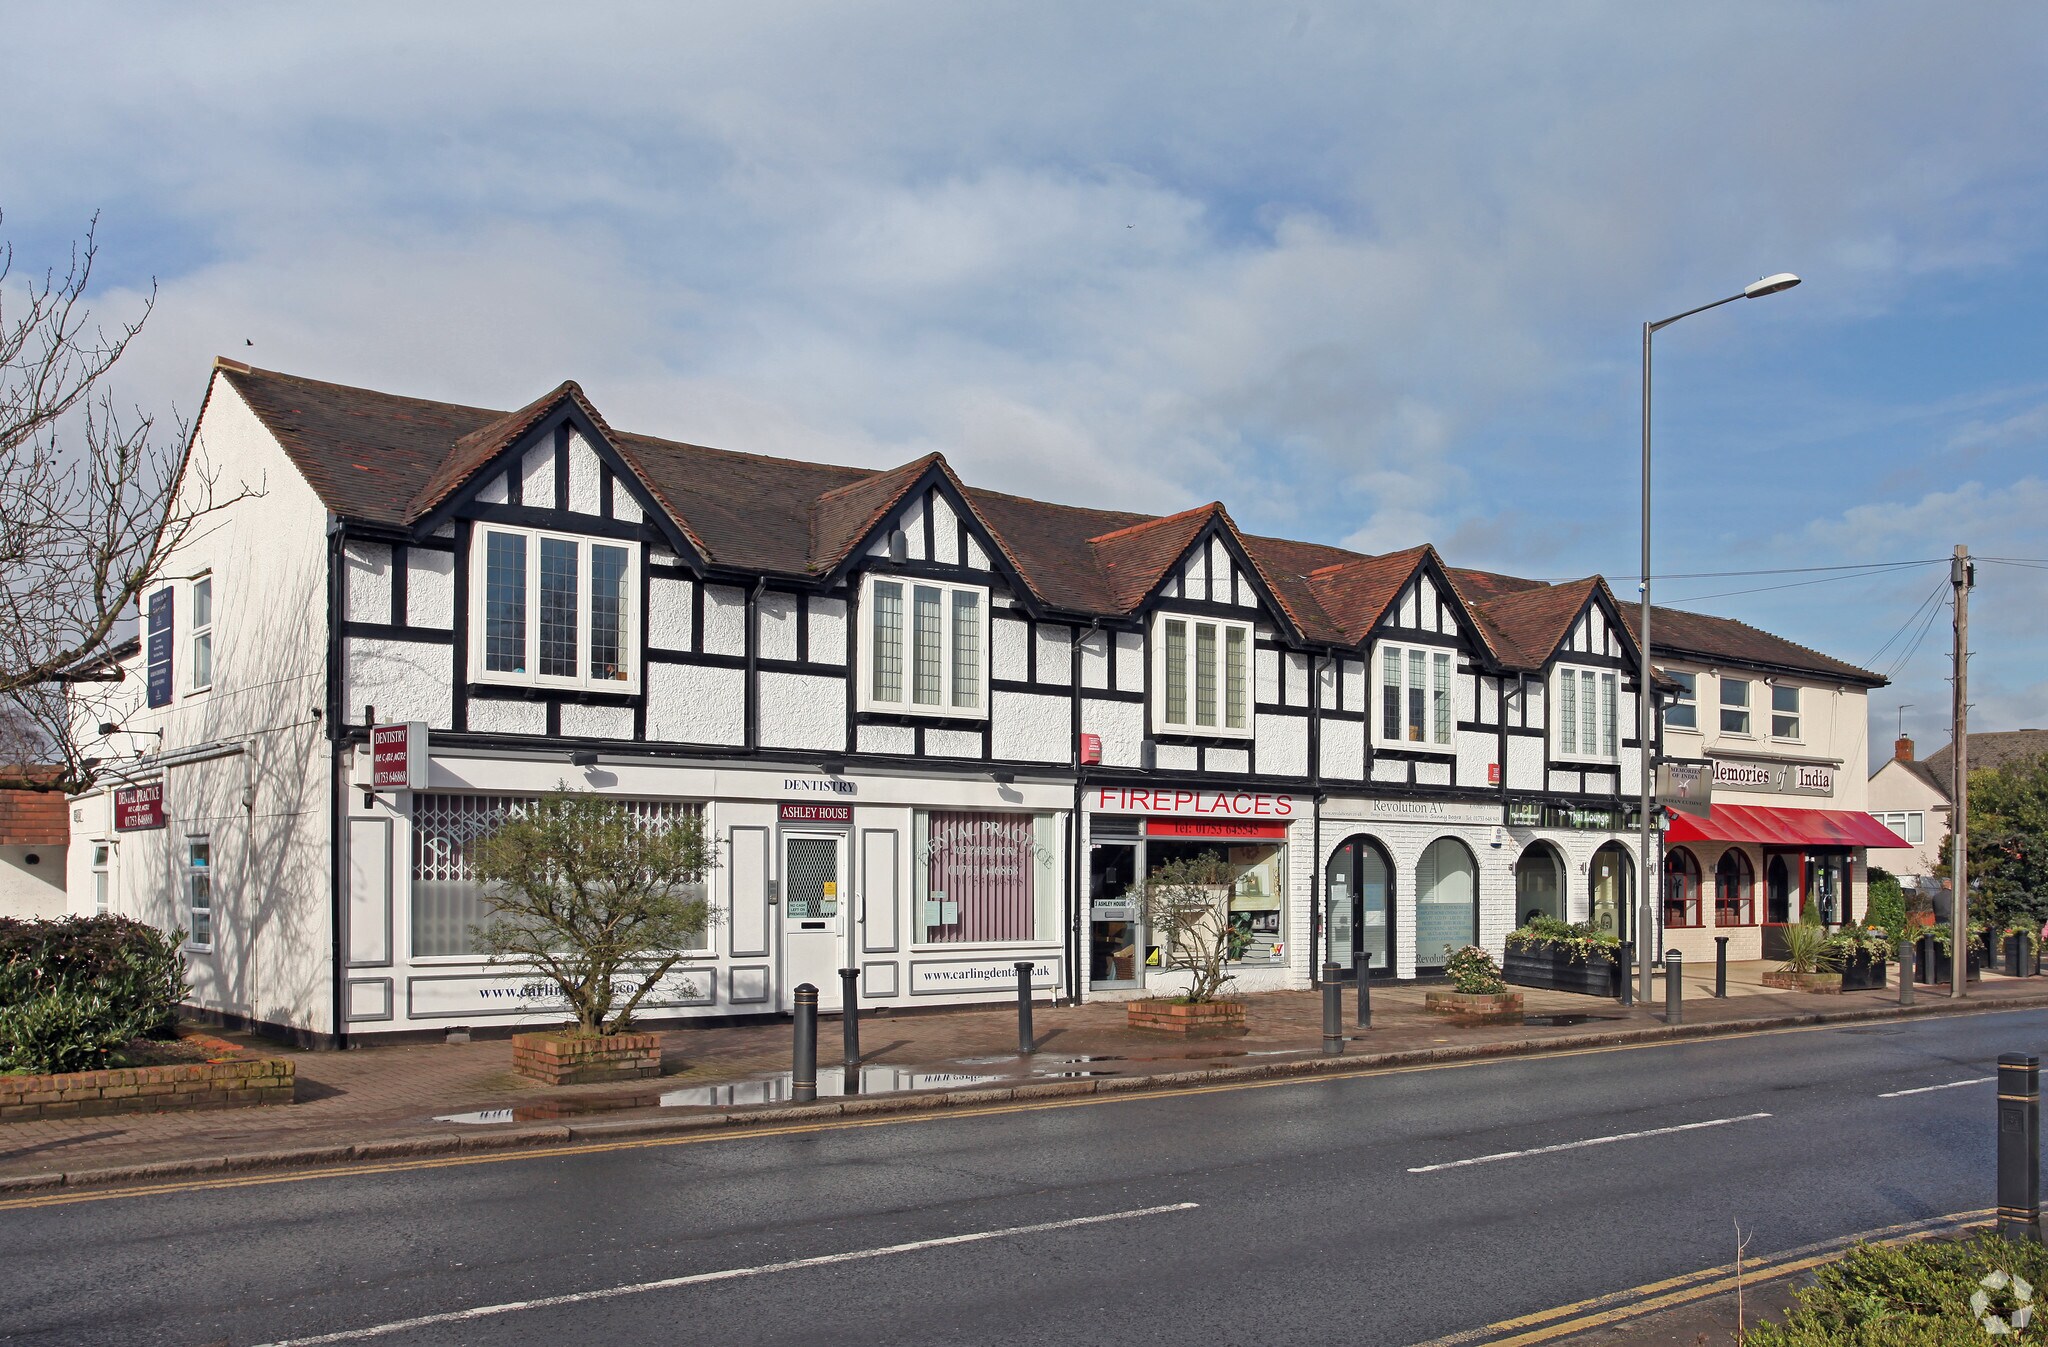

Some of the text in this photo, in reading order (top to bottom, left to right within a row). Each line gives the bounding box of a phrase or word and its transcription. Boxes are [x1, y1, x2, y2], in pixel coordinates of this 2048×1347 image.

[376, 730, 406, 744] DENTISTRY
[375, 772, 388, 784] 01753
[1777, 764, 1790, 792] of
[1799, 768, 1830, 788] India
[784, 779, 855, 792] DENTISTRY
[118, 786, 160, 805] DENTAL PRACTICE
[1100, 787, 1292, 815] FIREPLACES
[782, 806, 848, 819] ASHLEY HOUSE
[1373, 799, 1445, 814] Revolution AV
[1558, 809, 1610, 826] The Thai Lounge
[1196, 822, 1222, 835] 01753
[1226, 823, 1259, 836] 645545
